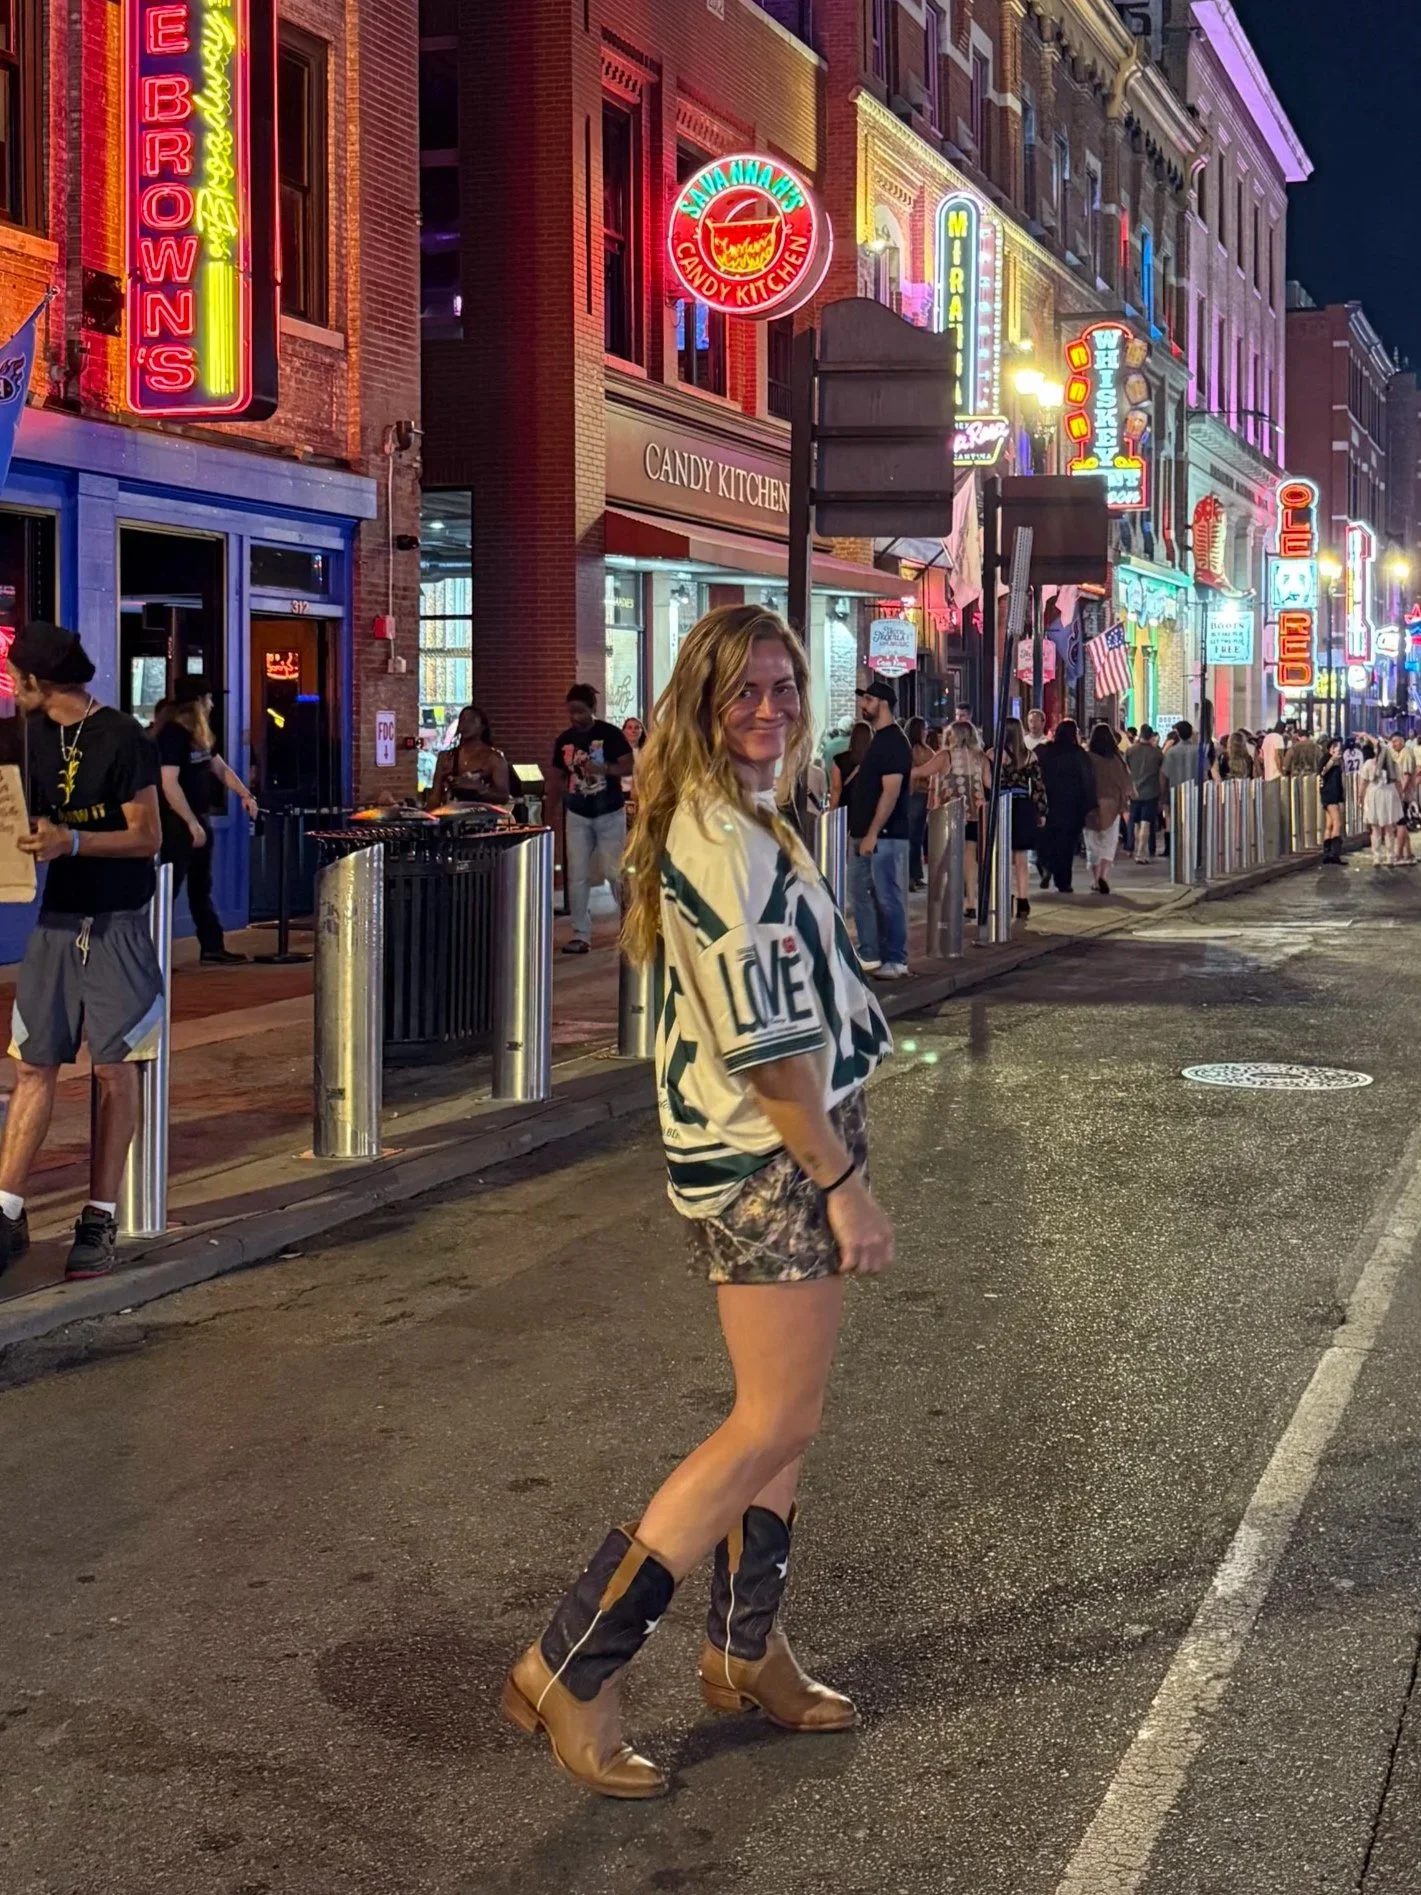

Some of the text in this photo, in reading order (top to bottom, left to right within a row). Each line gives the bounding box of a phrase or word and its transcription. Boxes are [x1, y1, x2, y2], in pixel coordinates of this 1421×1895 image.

[193, 10, 239, 237] Broadway
[679, 159, 805, 219] SAVANNAH'S
[138, 76, 198, 393] BROWN'S
[676, 235, 809, 306] CANDY KITCHEN
[1092, 329, 1122, 467] WHISKEY
[645, 442, 791, 514] CANDY KITCHEN
[1280, 483, 1312, 557] OLE
[291, 600, 310, 614] 312
[1278, 612, 1312, 686] RED
[378, 722, 394, 741] FDC
[1347, 759, 1360, 772] 27
[717, 939, 814, 1037] LOVE
